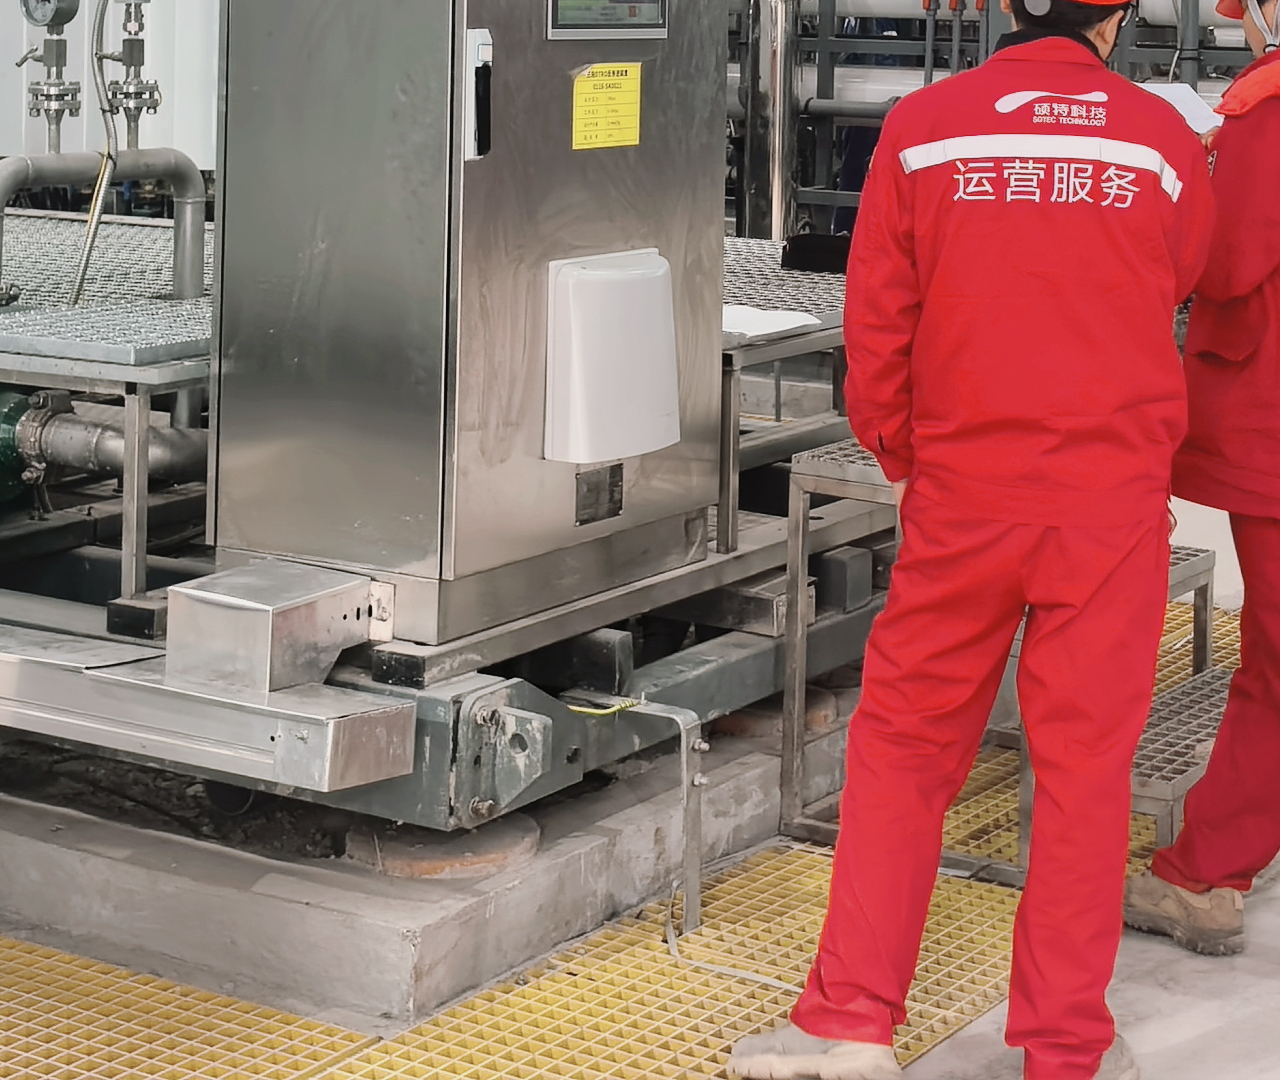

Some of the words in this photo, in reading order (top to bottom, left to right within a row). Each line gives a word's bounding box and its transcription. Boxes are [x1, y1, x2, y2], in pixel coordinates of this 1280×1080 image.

[1033, 103, 1107, 119] 硕特科技
[1032, 116, 1057, 124] SOTEC
[1059, 117, 1107, 127] TECHNOLOGY
[952, 159, 1141, 209] 运营服务
